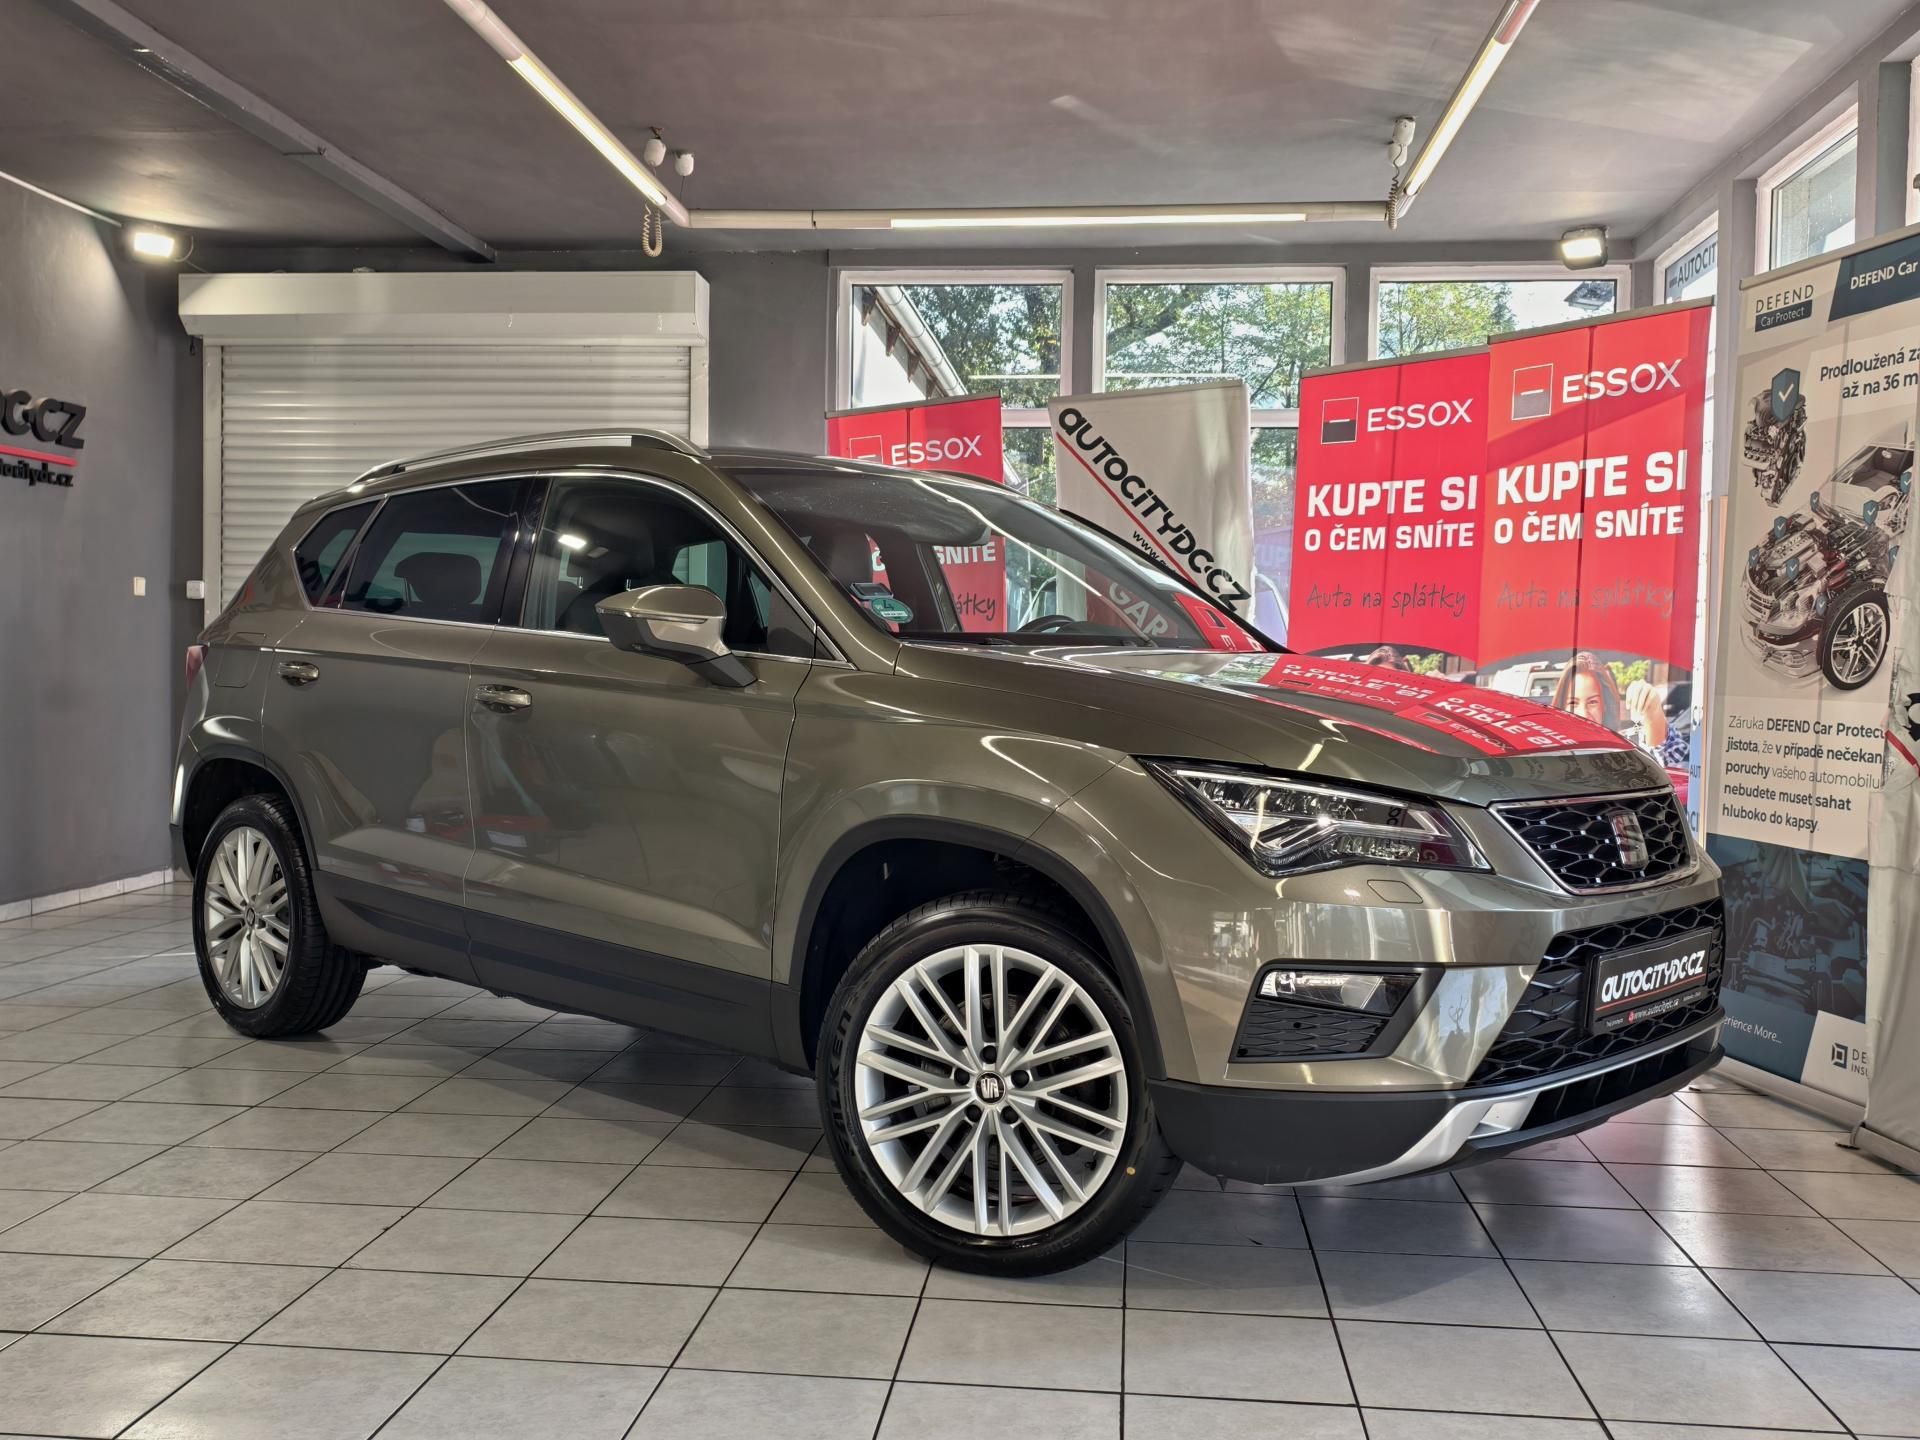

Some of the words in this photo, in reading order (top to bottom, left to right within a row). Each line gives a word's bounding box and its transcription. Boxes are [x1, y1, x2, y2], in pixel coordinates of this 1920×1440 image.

[1850, 265, 1895, 290] DEFEND
[1897, 260, 1919, 276] Car
[1755, 284, 1814, 313] DEFEND
[1760, 316, 1775, 327] Car
[1775, 306, 1805, 322] Protect
[1820, 346, 1905, 382] Prodloužená
[1562, 358, 1682, 403] ESSOX
[1842, 381, 1859, 399] až
[1863, 381, 1881, 396] na
[1883, 372, 1900, 391] 36
[1367, 398, 1473, 432] ESSOX
[891, 435, 982, 465] ESSOX
[1497, 455, 1628, 505] KUPTE
[1645, 449, 1688, 493] SI
[1307, 480, 1425, 518] KUPTE
[1440, 475, 1478, 510] SI
[1305, 529, 1320, 552] O
[1329, 524, 1386, 551] ČEM
[1395, 519, 1474, 549] SNÍTE
[1494, 518, 1513, 544] O
[1522, 511, 1583, 542] ČEM
[1594, 502, 1684, 540] SNÍTE
[1305, 584, 1352, 609] Auta
[1362, 590, 1383, 609] na
[1391, 583, 1466, 618] splátky
[1497, 580, 1547, 610] Auta
[1557, 588, 1579, 608] na
[1591, 577, 1675, 619] splátky
[1728, 715, 1764, 730] Záruka
[1766, 718, 1810, 733] DEFEND
[1813, 720, 1833, 735] Car
[1762, 740, 1774, 754] že
[1775, 744, 1782, 754] v
[1783, 742, 1824, 760] případě
[1725, 762, 1770, 779] poruchy
[1771, 765, 1807, 781] vašeho
[1724, 783, 1776, 800] nebudete
[1778, 790, 1813, 806] muset
[1815, 794, 1852, 811] sahat
[1722, 803, 1767, 822] hluboko
[1769, 810, 1783, 825] do
